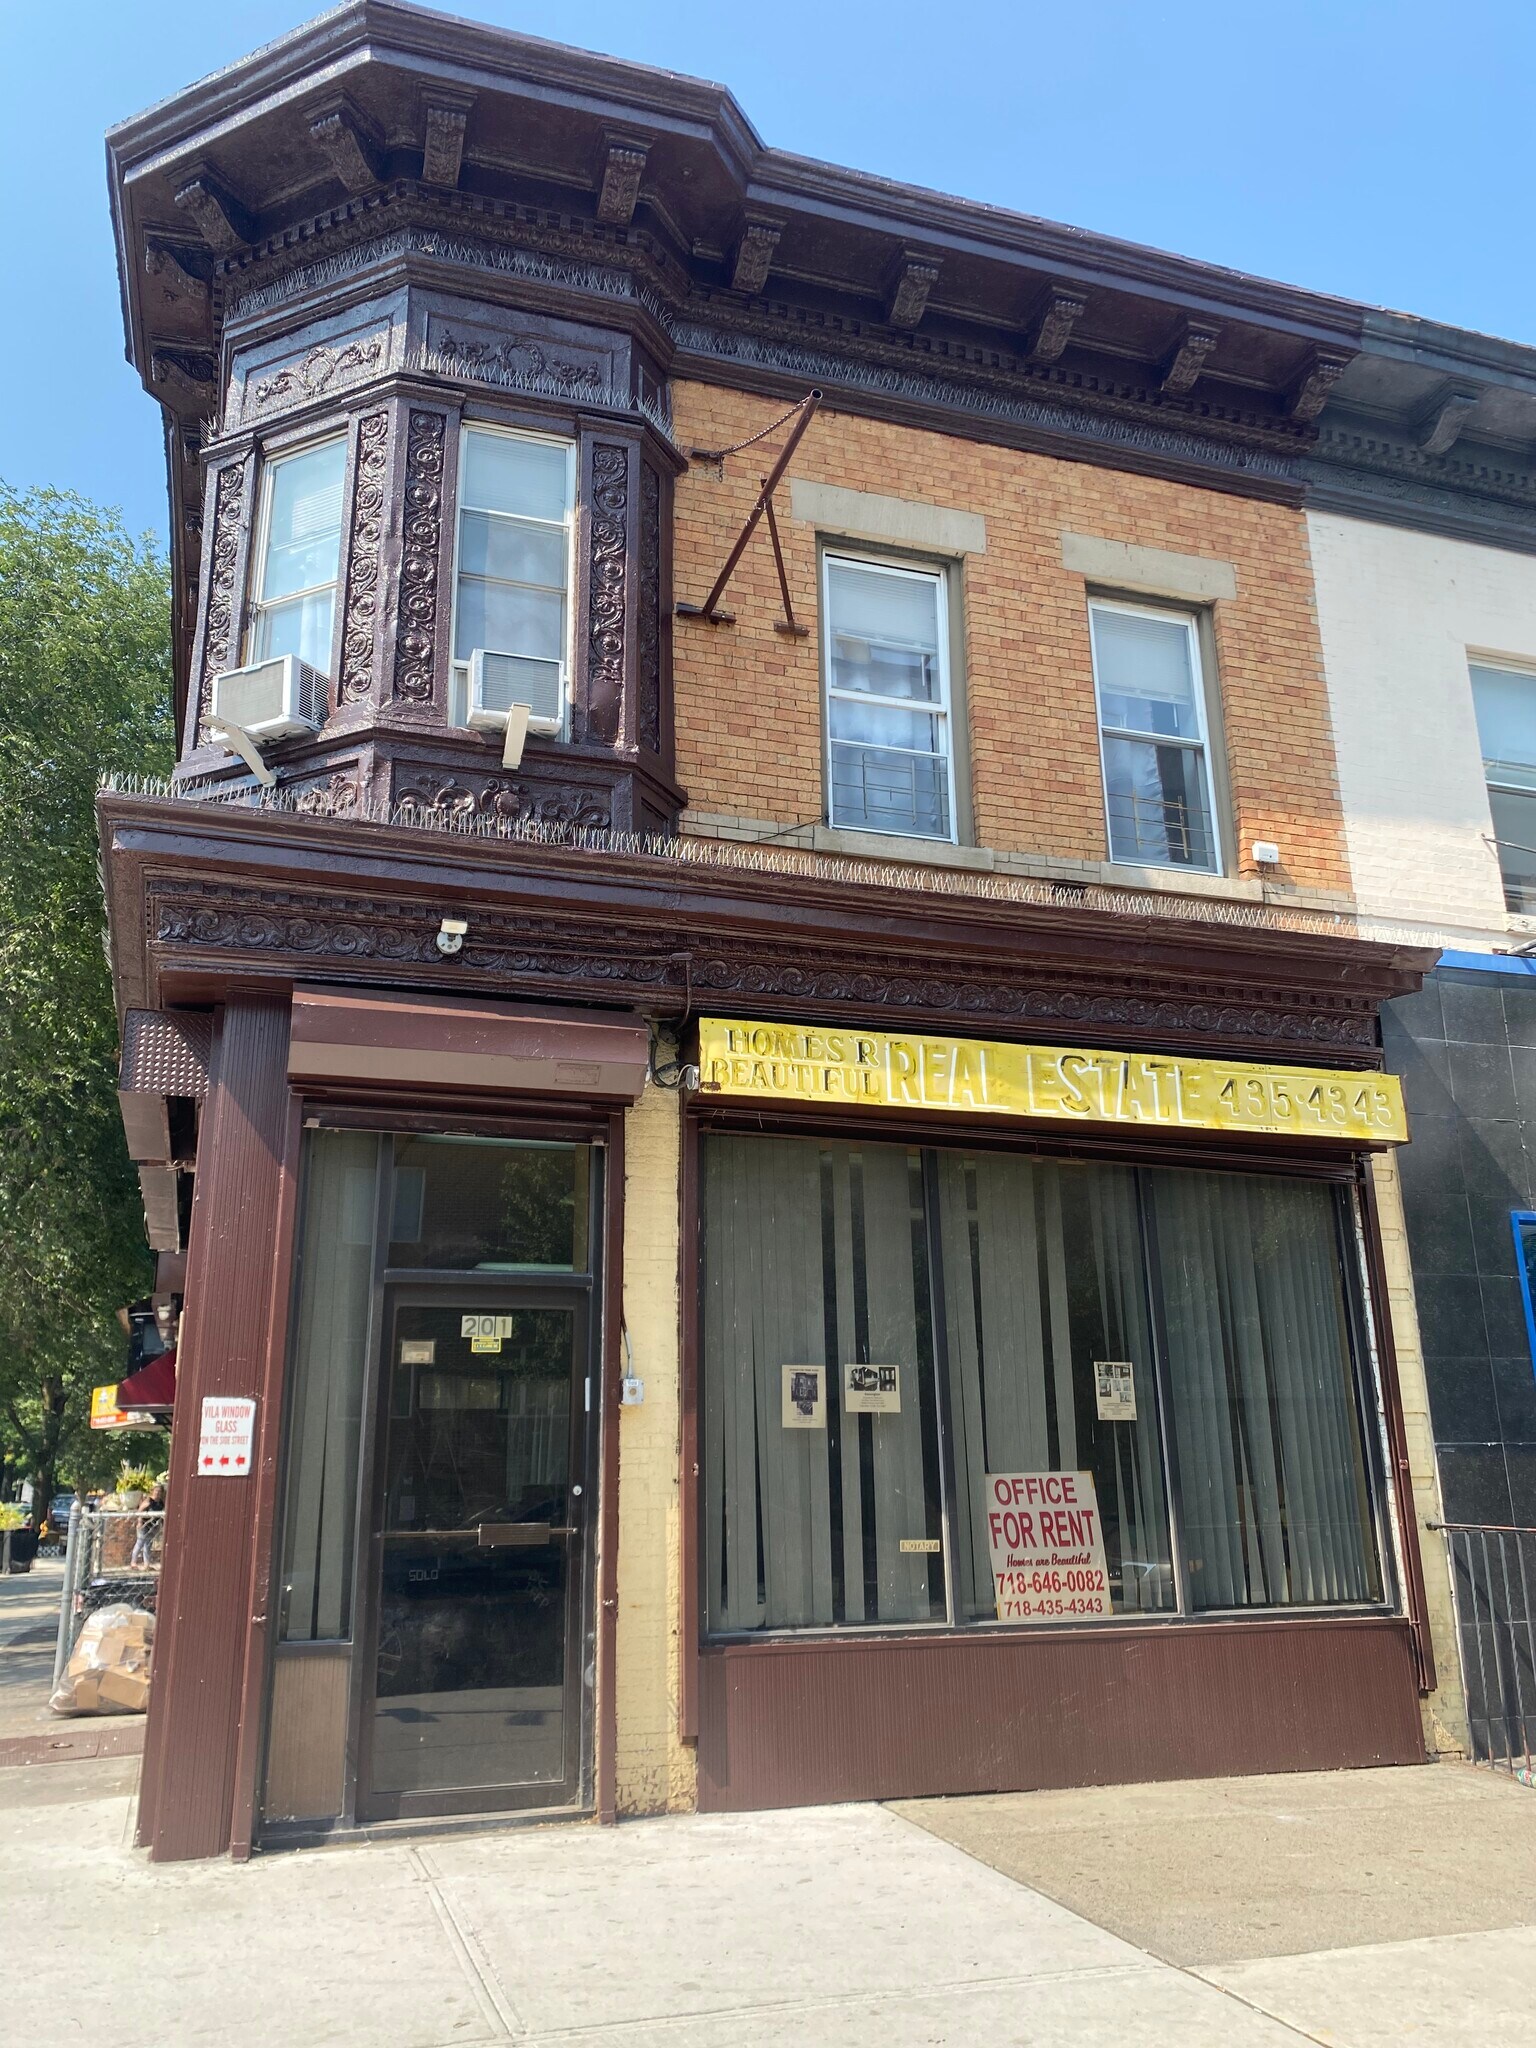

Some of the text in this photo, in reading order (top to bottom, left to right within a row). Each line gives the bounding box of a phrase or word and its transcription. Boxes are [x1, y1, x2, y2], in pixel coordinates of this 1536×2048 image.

[725, 1027, 846, 1063] HOMES
[709, 1057, 880, 1098] BEAUTIFUL
[884, 1041, 1205, 1124] REAL ESTATE
[464, 1317, 508, 1336] 201
[222, 1406, 250, 1418] WINDOW
[215, 1421, 237, 1433] GLASS
[232, 1436, 249, 1445] STREET
[994, 1477, 1077, 1506] OFFICE
[989, 1510, 1094, 1549] FOR RENT
[902, 1542, 936, 1550] NOTARY
[1007, 1552, 1091, 1568] Homes are Beautiful
[996, 1570, 1105, 1595] 718-646-0082
[1004, 1598, 1103, 1617] 718-435-4343
